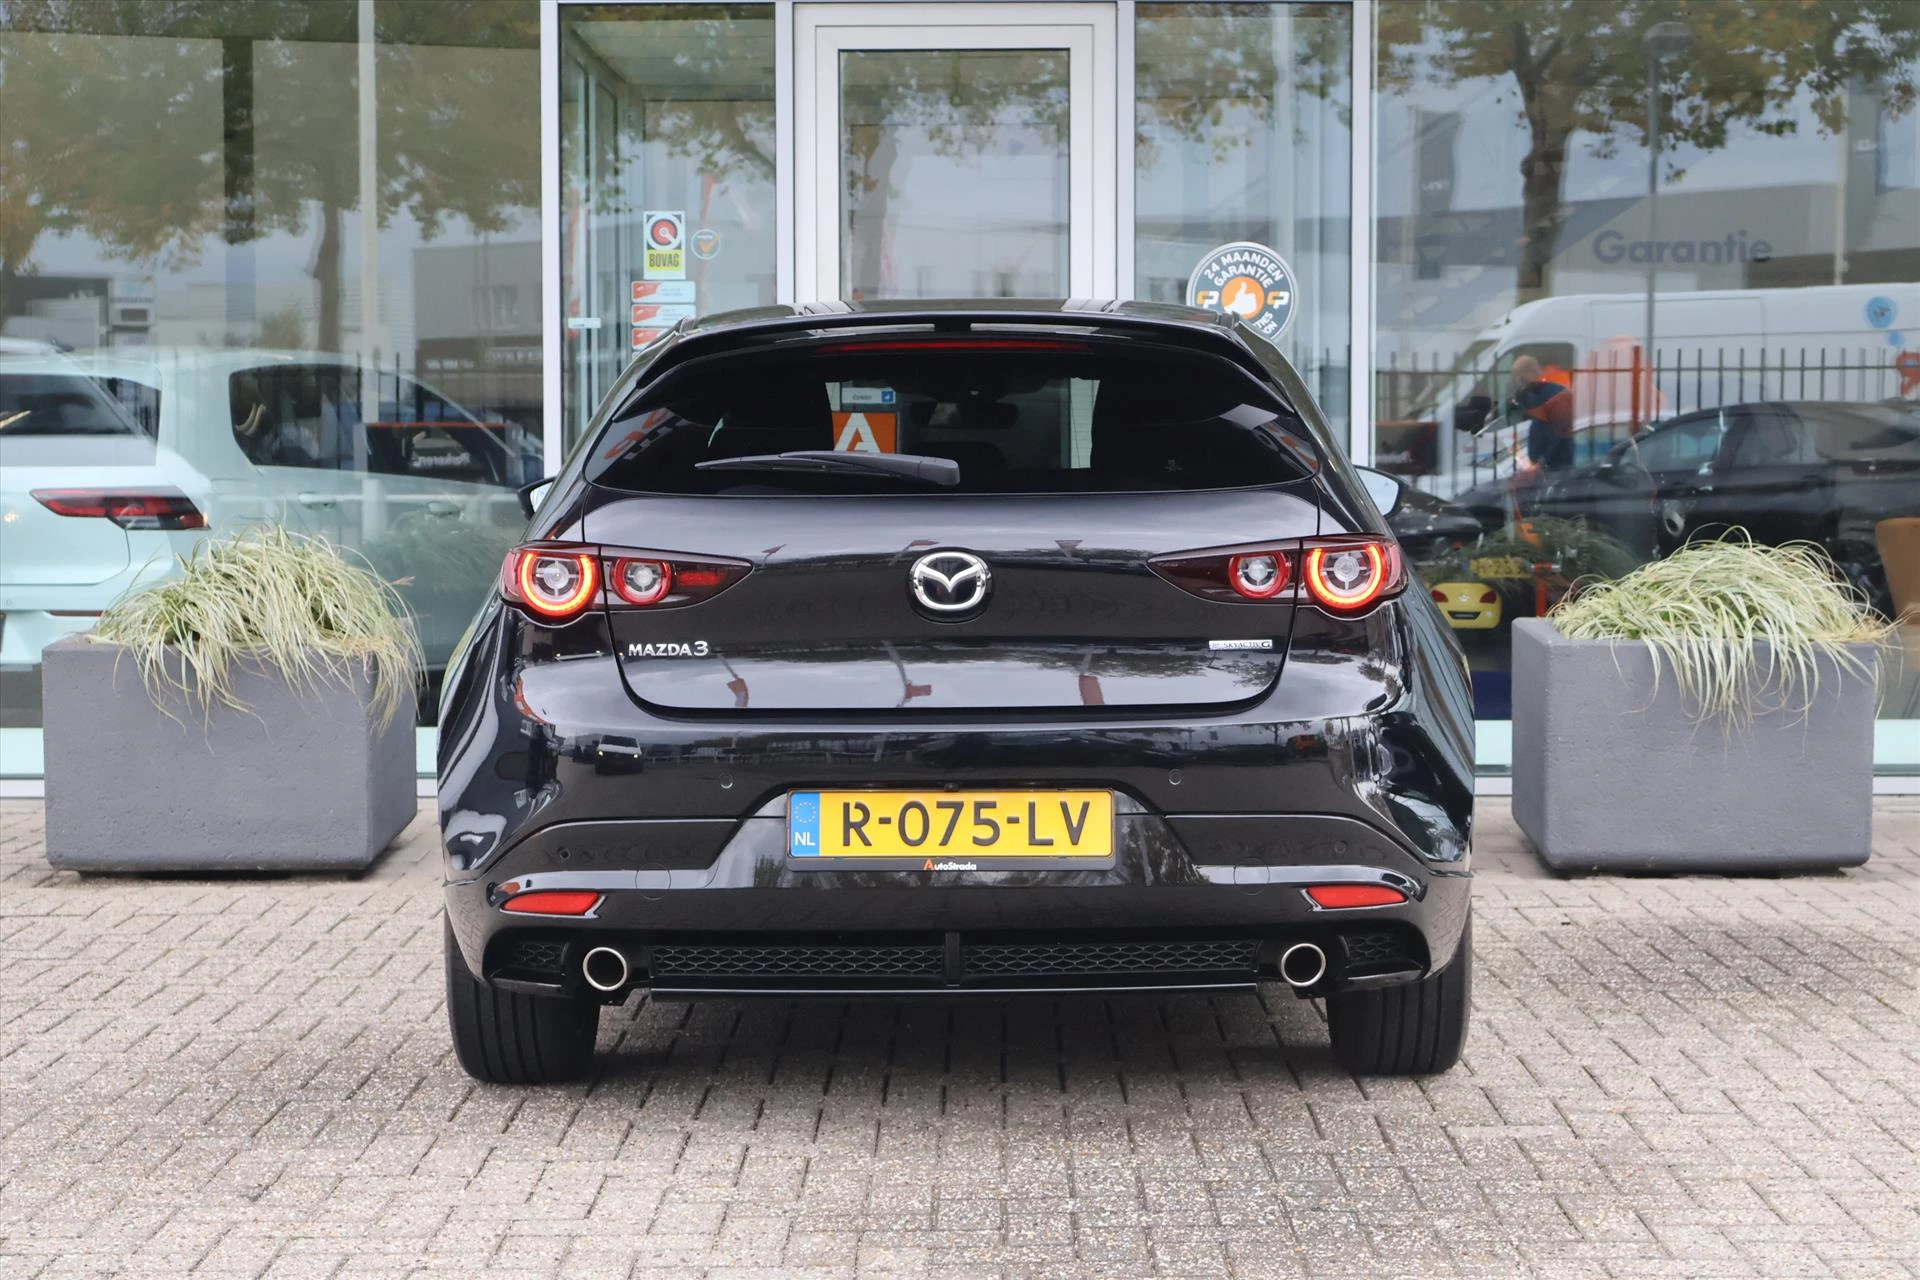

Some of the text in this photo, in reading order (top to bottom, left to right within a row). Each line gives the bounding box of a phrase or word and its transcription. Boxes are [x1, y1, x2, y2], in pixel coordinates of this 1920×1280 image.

[1593, 229, 1774, 265] Garantie
[649, 253, 679, 267] BOVAG
[1204, 251, 1284, 281] 24 MAANDEN
[1214, 264, 1274, 288] GARANTIE
[628, 641, 709, 656] MAZDA3
[842, 800, 1091, 847] R-075-LV
[795, 832, 815, 846] NL
[922, 858, 977, 871] AutoStrada
